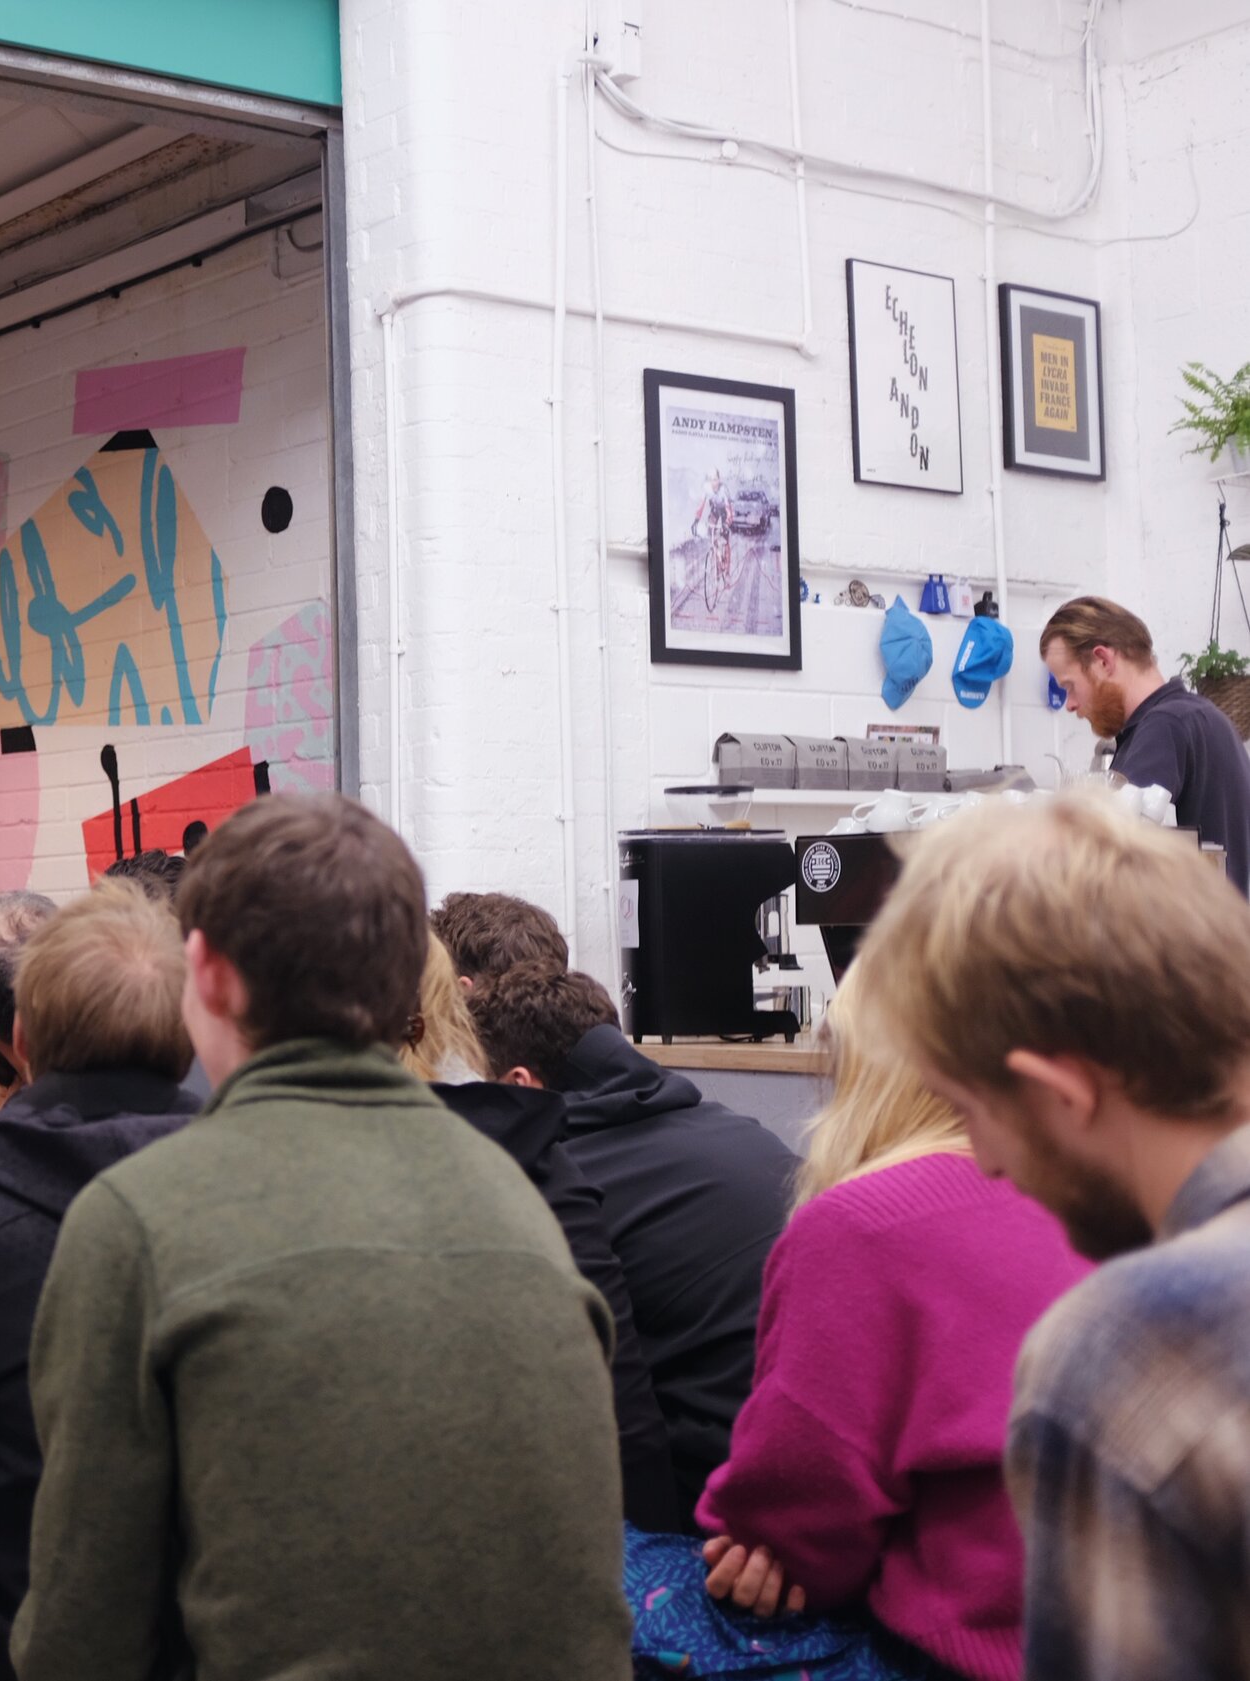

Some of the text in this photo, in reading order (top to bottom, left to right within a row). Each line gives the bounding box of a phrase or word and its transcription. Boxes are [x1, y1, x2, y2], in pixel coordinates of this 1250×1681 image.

[1040, 352, 1069, 368] MEN IN
[1043, 366, 1068, 380] LYCRA
[1041, 379, 1069, 393] INVADE
[889, 377, 919, 430] AND
[1040, 392, 1071, 408] FRANCE
[1044, 407, 1069, 420] AGAIN
[672, 416, 774, 439] ANDY HAMPSTEN
[910, 433, 929, 471] ON
[753, 743, 783, 752] CLIFTON
[809, 745, 836, 753] CLIFTON
